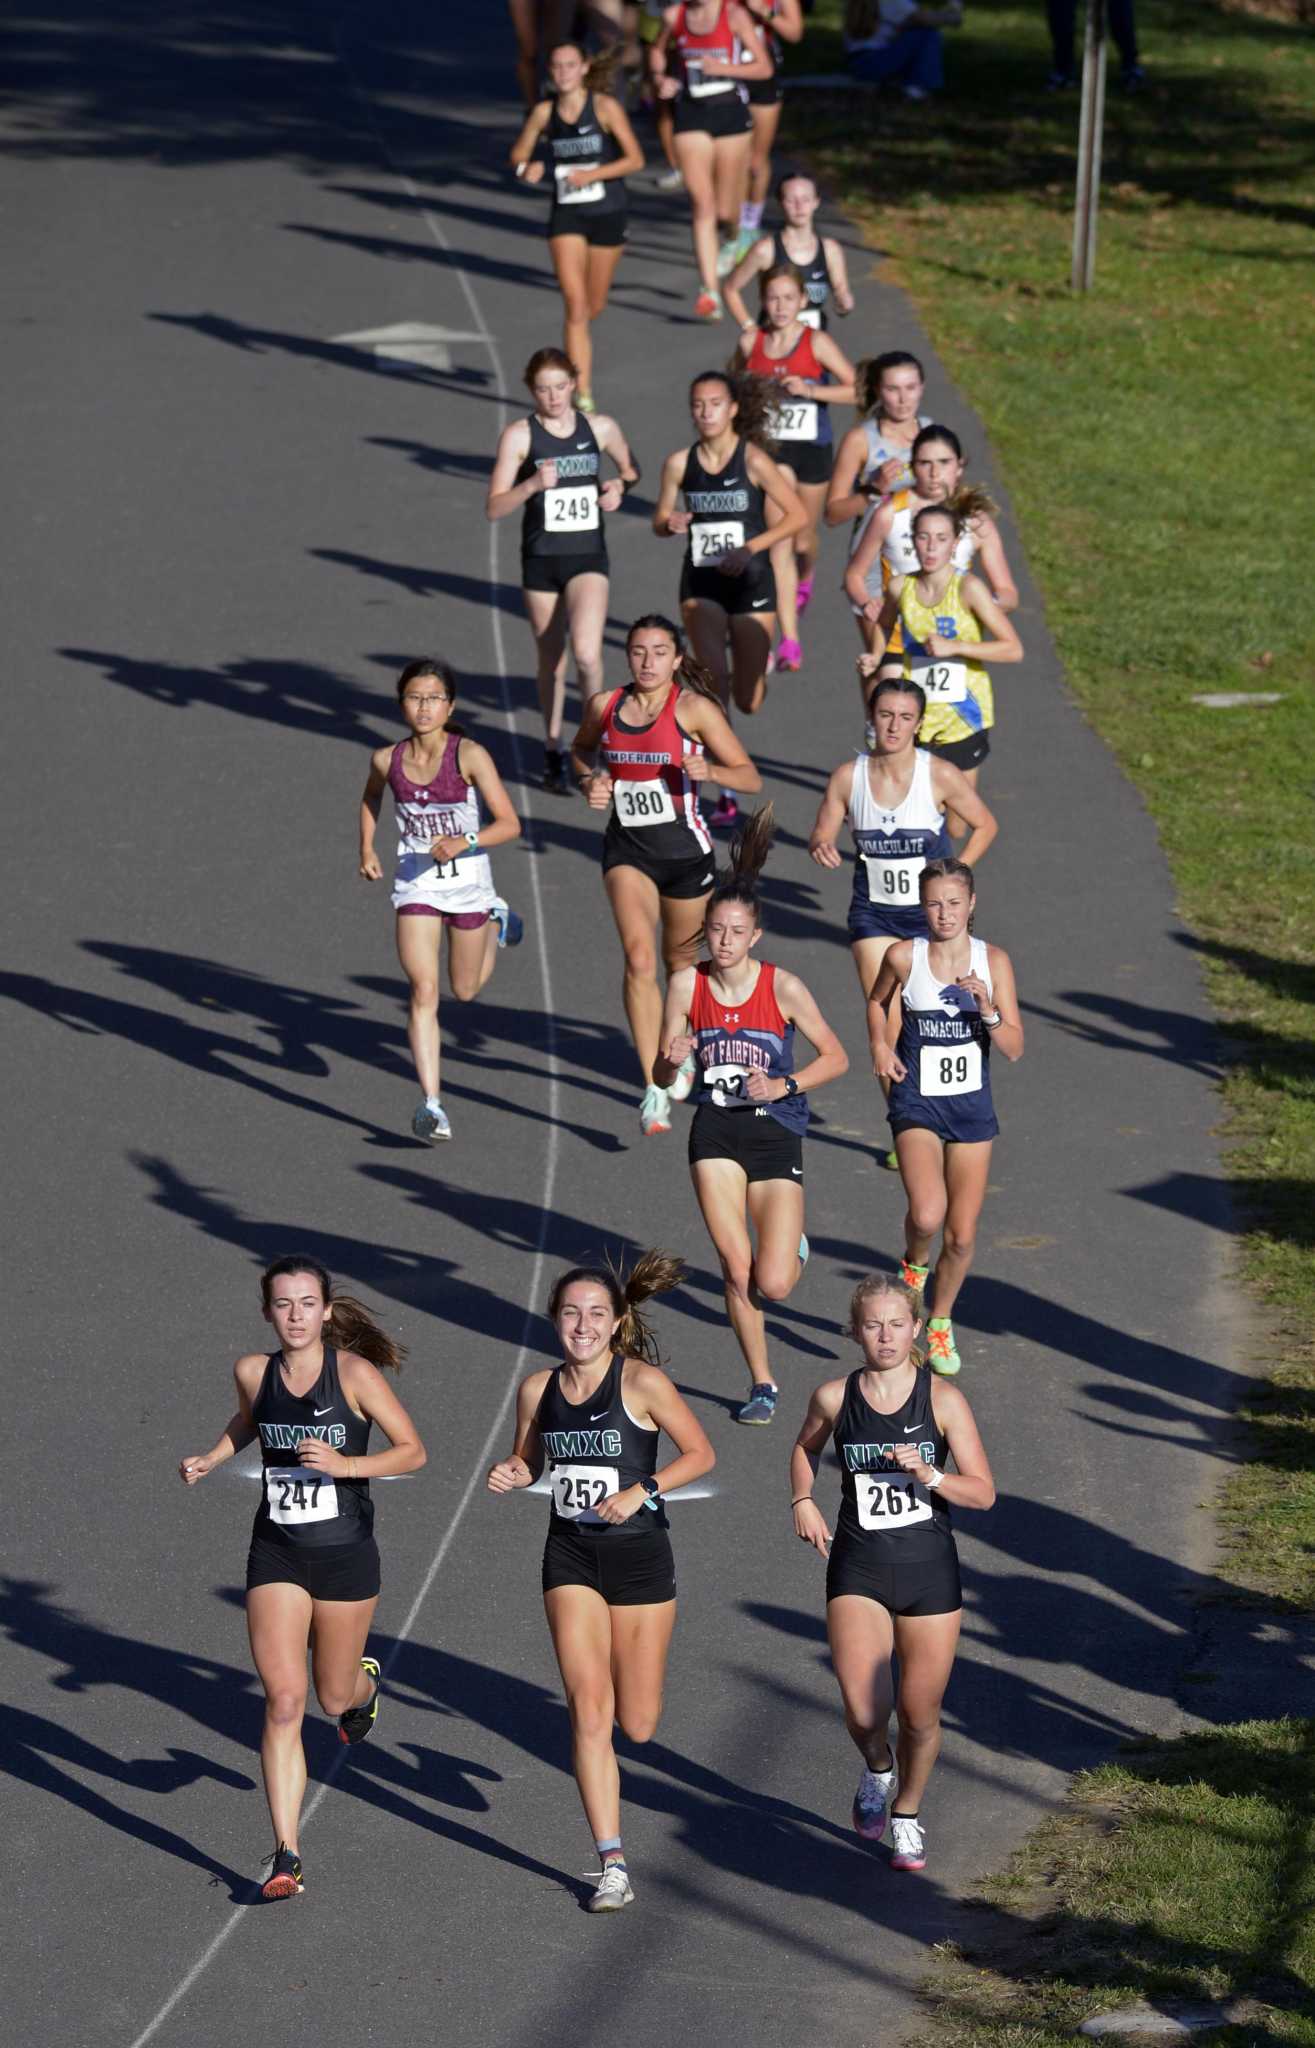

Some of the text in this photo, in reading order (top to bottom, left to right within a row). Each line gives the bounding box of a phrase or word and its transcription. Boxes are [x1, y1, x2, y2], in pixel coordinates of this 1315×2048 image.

[534, 452, 599, 478] MXC
[554, 496, 590, 522] 249
[700, 532, 736, 557] 256
[935, 616, 958, 639] B
[925, 667, 950, 692] 42
[622, 790, 665, 817] 380
[883, 869, 911, 895] 96
[718, 1039, 772, 1073] FAIRFIELD
[939, 1055, 968, 1084] 89
[842, 1441, 935, 1473] NMC
[276, 1477, 323, 1512] 247
[559, 1477, 608, 1511] 252
[867, 1482, 920, 1517] 261
